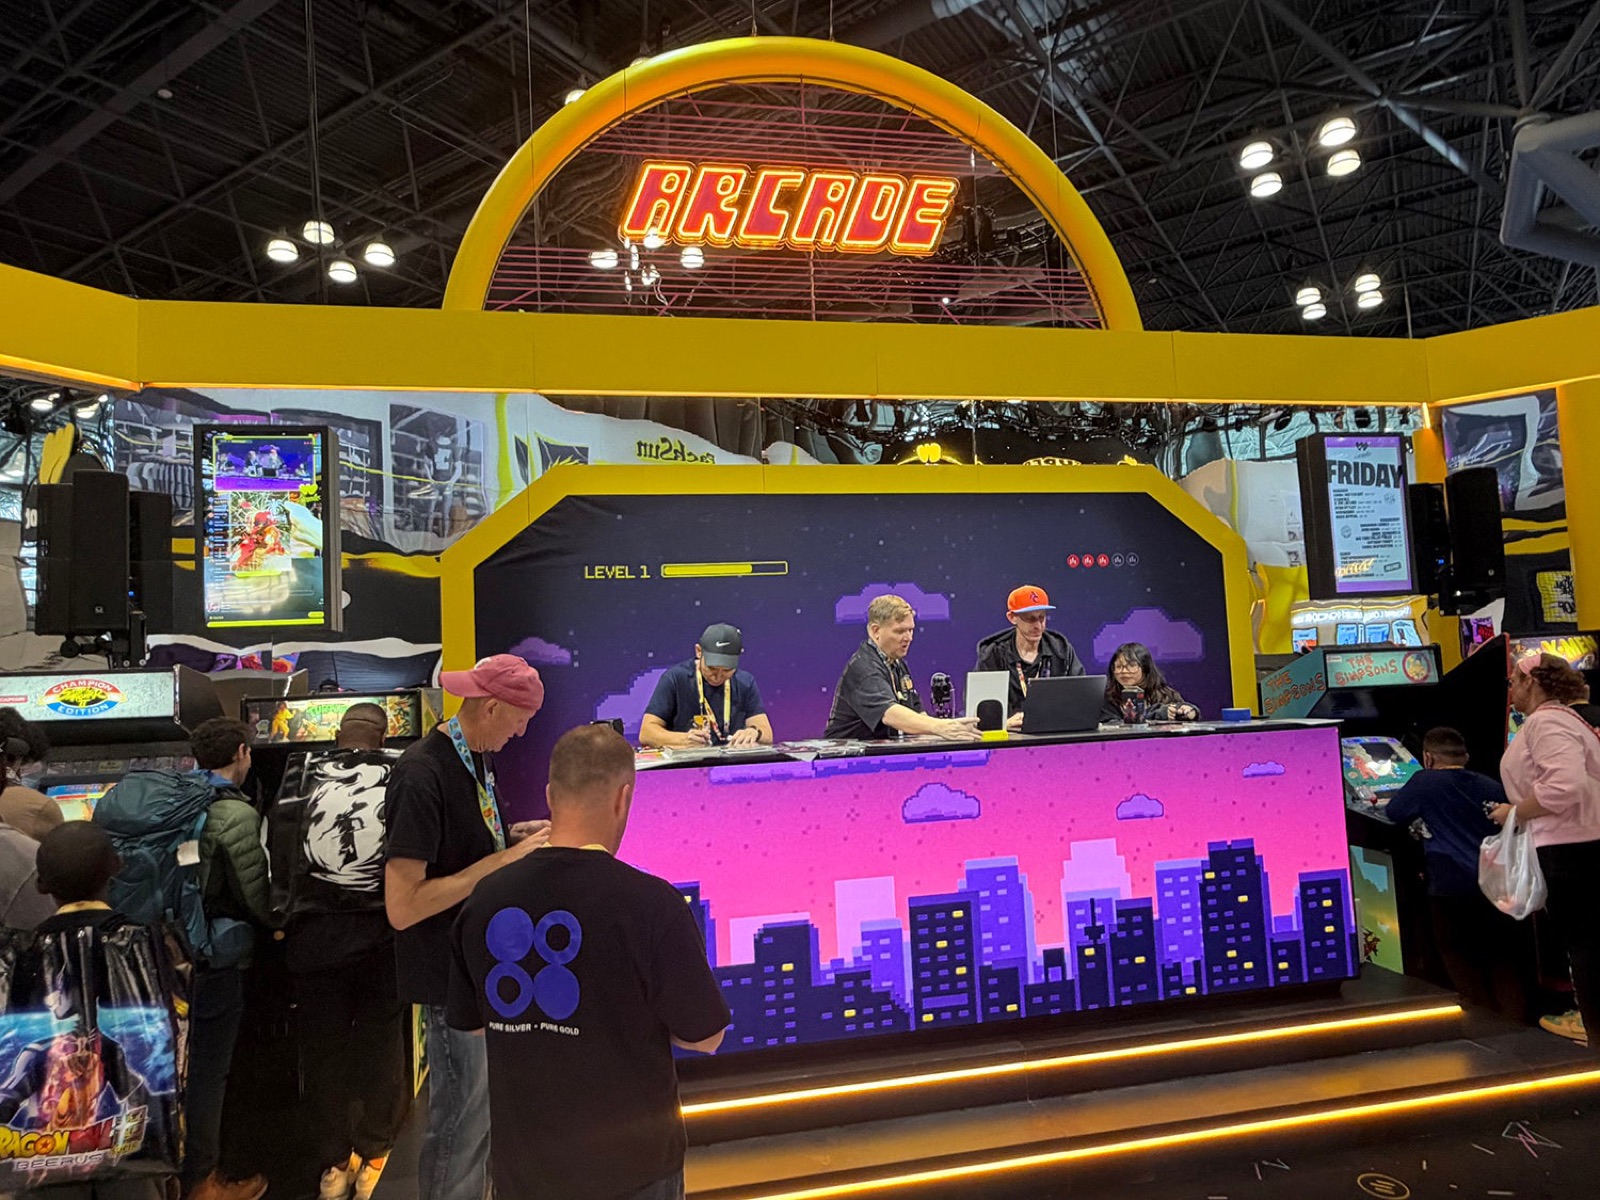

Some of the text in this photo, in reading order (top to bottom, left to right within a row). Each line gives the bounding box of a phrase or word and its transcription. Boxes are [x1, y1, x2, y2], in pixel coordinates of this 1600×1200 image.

[620, 161, 958, 255] ARCADE
[1326, 459, 1403, 489] FRIDAY
[584, 564, 651, 579] LEVEL 1
[1345, 652, 1374, 668] THE
[1265, 670, 1292, 692] THE
[1334, 658, 1399, 687] SIMPSONS
[52, 679, 113, 694] CHAMPION
[1263, 671, 1326, 716] SIMPSONS
[57, 703, 110, 716] EDITION
[504, 1023, 532, 1032] SILVER
[540, 1022, 559, 1033] PURE
[559, 1026, 580, 1036] GOLD
[15, 1153, 104, 1171] BEERUS
